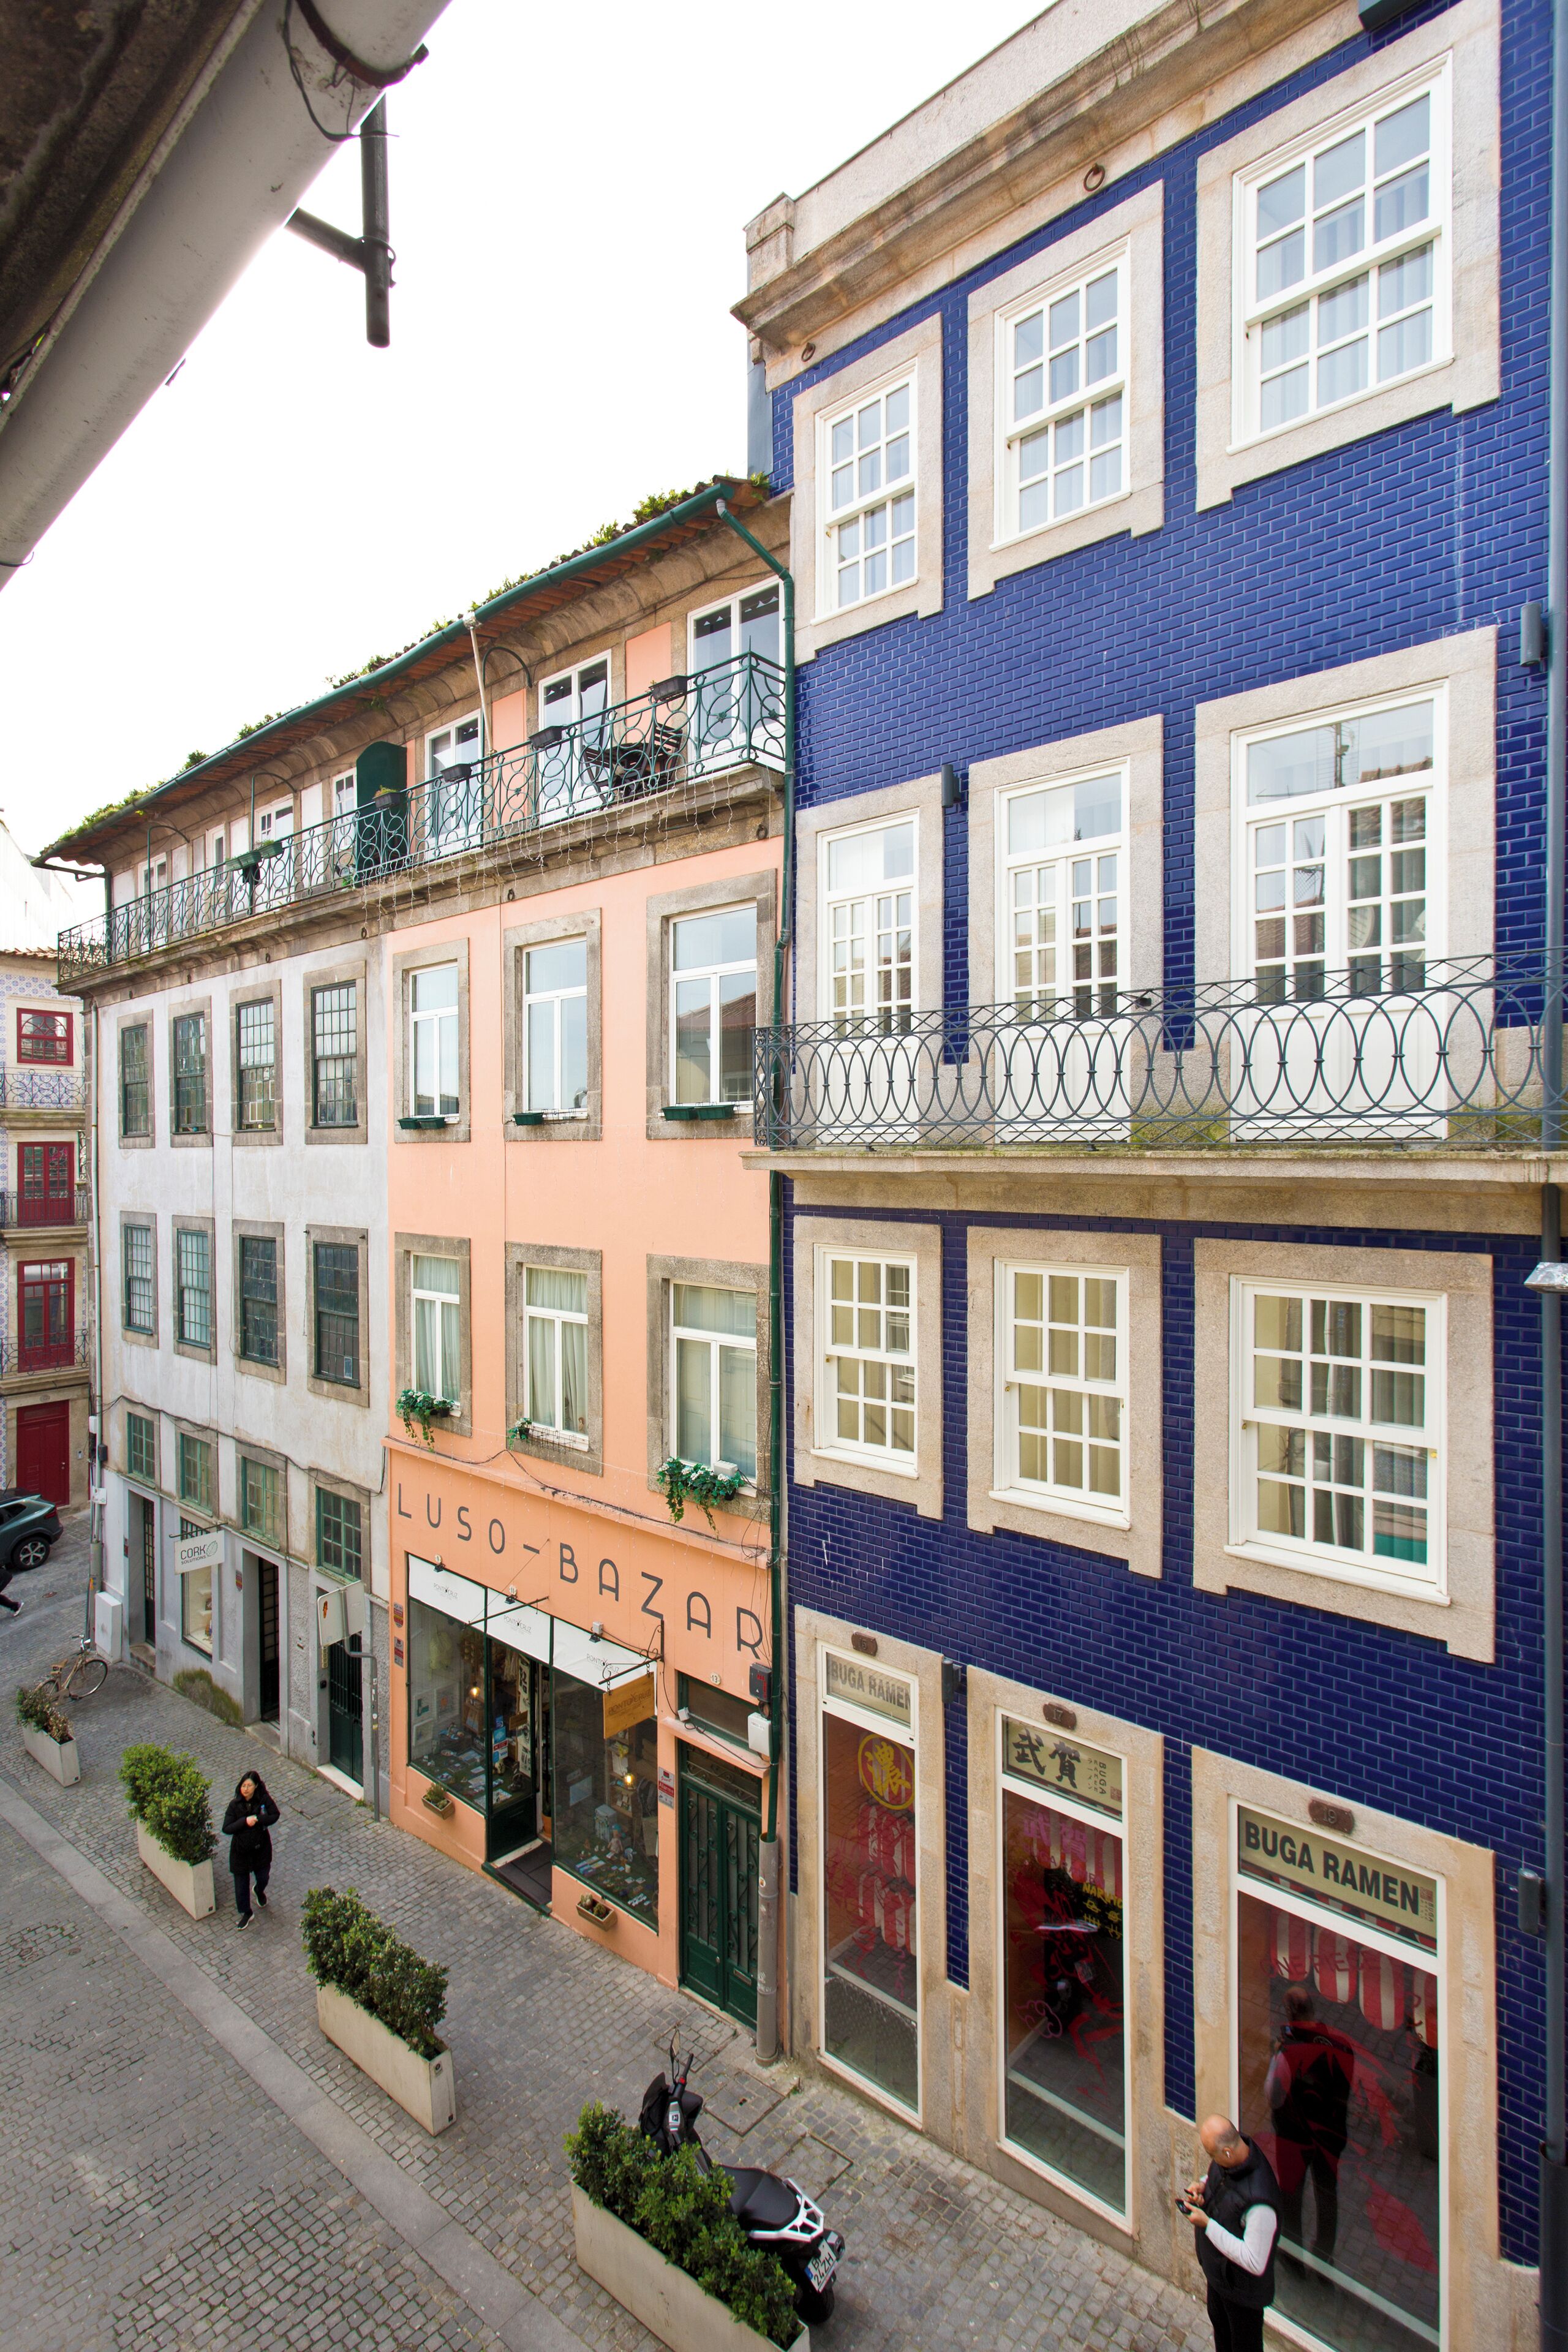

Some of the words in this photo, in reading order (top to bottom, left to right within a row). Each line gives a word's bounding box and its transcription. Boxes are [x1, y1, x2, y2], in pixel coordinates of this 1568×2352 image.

[181, 1544, 206, 1560] CORK
[181, 1555, 206, 1565] SOLUTIONS
[712, 1675, 718, 1683] 13
[831, 1660, 865, 1692] BUGA
[1053, 1708, 1063, 1722] 17
[1323, 1808, 1338, 1823] 19
[1245, 1820, 1315, 1874] BUGA
[1323, 1850, 1420, 1916] RAMEN
